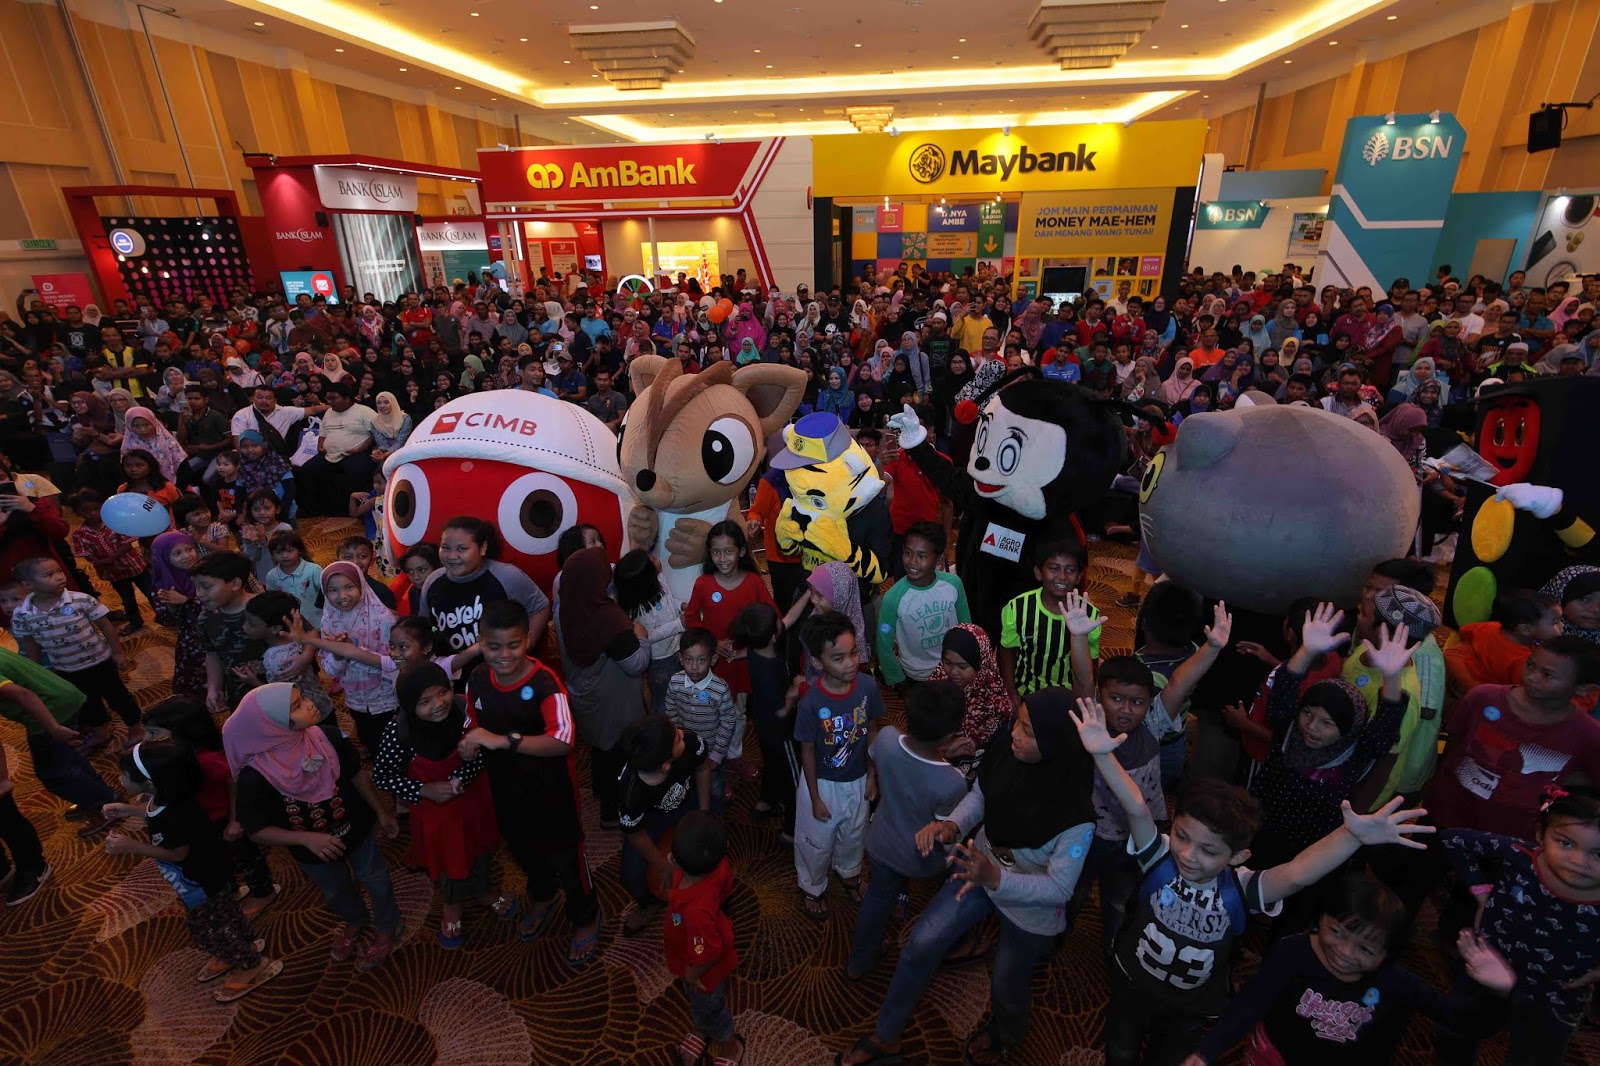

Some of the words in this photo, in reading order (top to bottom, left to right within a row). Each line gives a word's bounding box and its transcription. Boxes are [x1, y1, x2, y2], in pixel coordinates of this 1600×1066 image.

[1392, 135, 1453, 160] BSN
[950, 143, 1097, 182] Maybank
[569, 156, 697, 188] AmBank
[338, 180, 370, 197] BANK
[373, 183, 404, 199] ISLAM
[1037, 206, 1060, 216] JOM
[1062, 206, 1090, 215] MAIN
[1092, 204, 1158, 214] PERMAINAN
[1224, 208, 1258, 222] BSN
[942, 217, 966, 226] AMBE
[1035, 216, 1086, 228] MONEY
[1089, 214, 1156, 227] MAE-HEM
[276, 231, 298, 240] BANK
[300, 230, 323, 240] ISLAM
[421, 231, 446, 241] BANK
[450, 231, 477, 241] ISLAM
[1034, 230, 1053, 238] DAN
[1055, 229, 1093, 237] MENANG
[1095, 228, 1122, 236] WANG
[465, 412, 538, 436] CIMB
[998, 542, 1020, 555] BANK
[1000, 536, 1021, 548] AGRO
[908, 600, 955, 623] LEAGUE
[1135, 921, 1216, 990] 23
